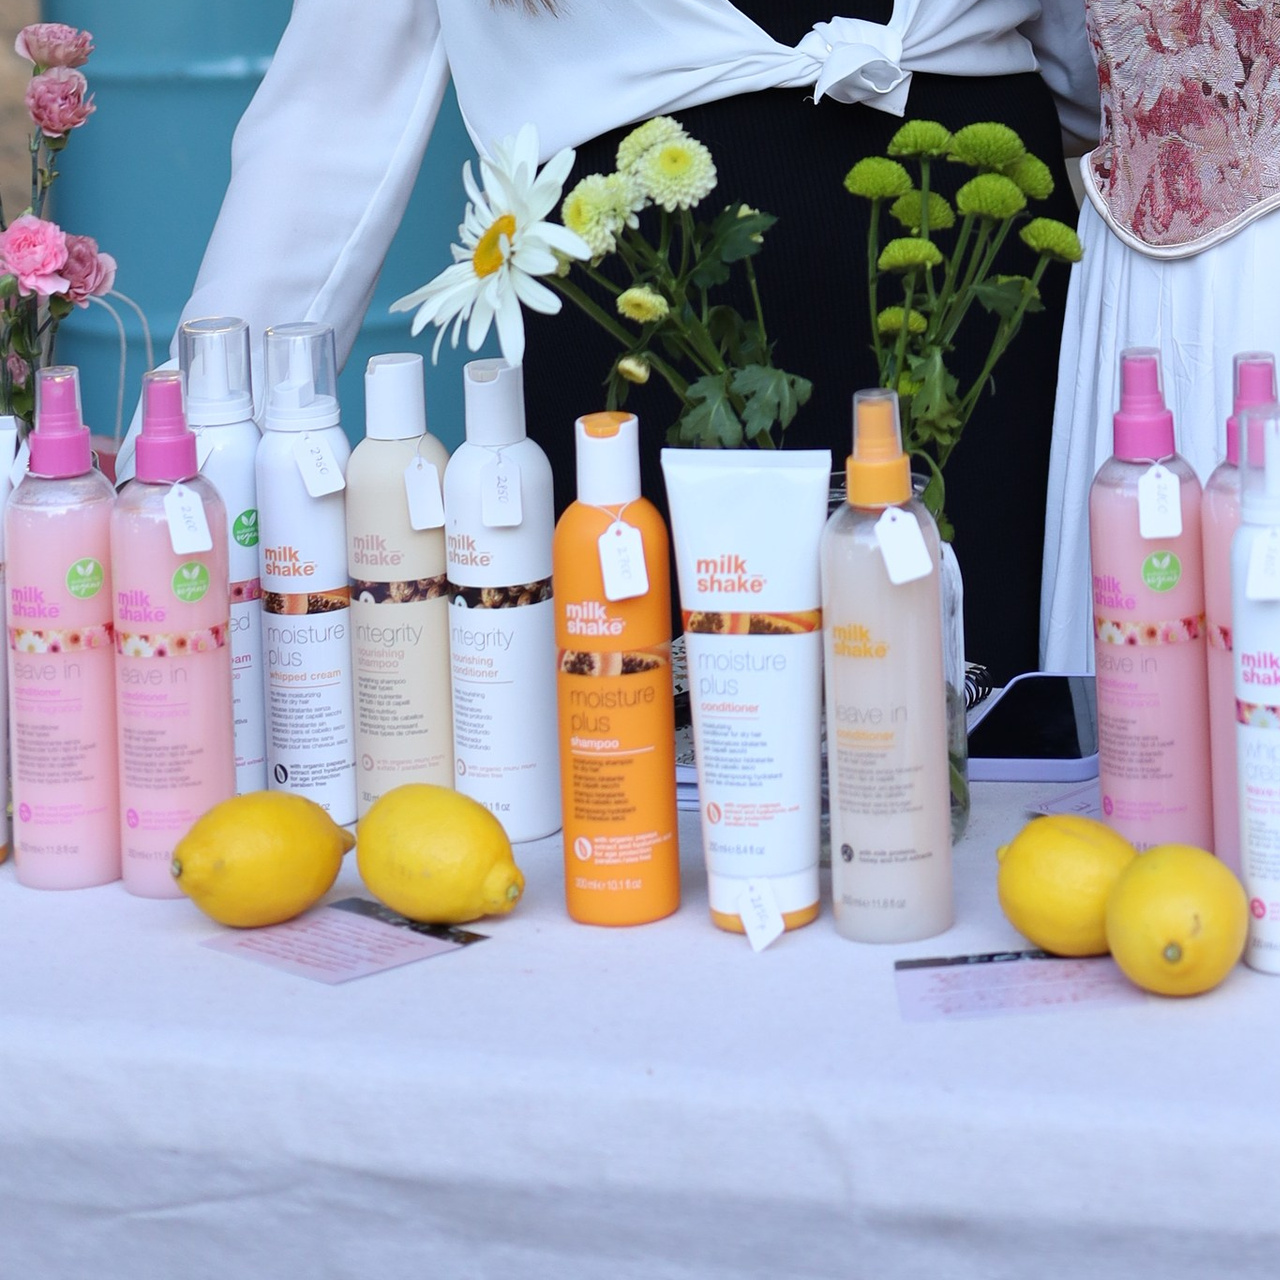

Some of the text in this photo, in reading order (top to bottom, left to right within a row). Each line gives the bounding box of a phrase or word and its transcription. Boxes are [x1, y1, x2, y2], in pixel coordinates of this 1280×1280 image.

[353, 535, 386, 551] milk
[448, 535, 475, 551] milk
[265, 547, 299, 561] milk
[354, 551, 401, 566] shake
[449, 552, 490, 566] shake
[266, 562, 315, 576] shake
[696, 555, 747, 575] milk
[697, 575, 763, 593] shake
[12, 587, 44, 603] milk
[118, 591, 150, 607] milk
[12, 603, 60, 618] shake
[119, 607, 165, 622] shake
[565, 601, 606, 620] milk
[268, 624, 345, 644] moisture
[567, 618, 622, 636] shake
[269, 647, 303, 667] plus
[698, 650, 787, 673] moisture
[1241, 651, 1280, 670] milk
[270, 669, 341, 681] whipped cream
[700, 674, 739, 698] plus
[571, 686, 655, 710] moisture
[701, 702, 760, 713] conditioner
[891, 703, 908, 722] in
[572, 711, 610, 734] plus
[570, 738, 619, 750] shampoo
